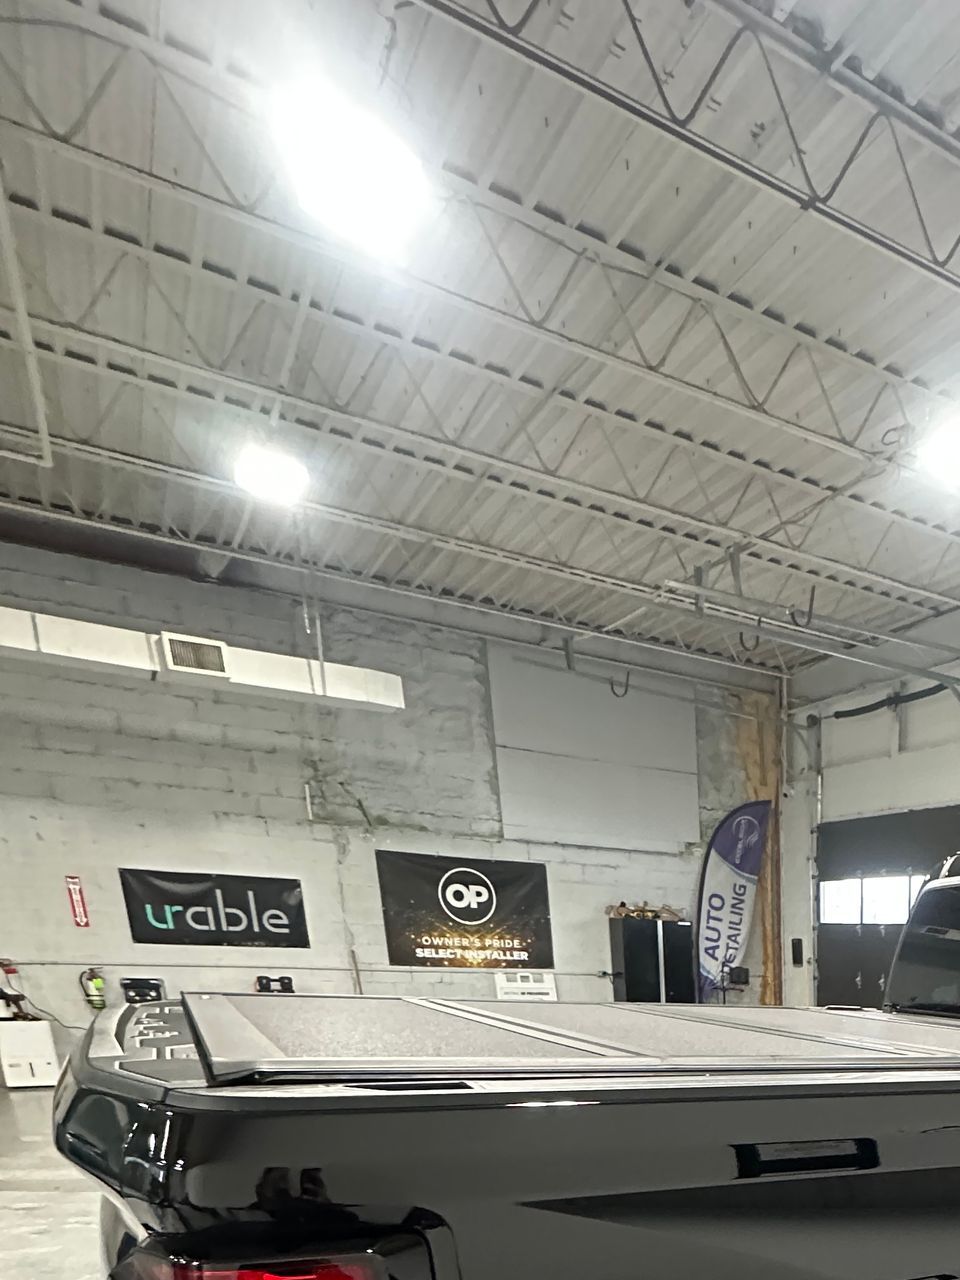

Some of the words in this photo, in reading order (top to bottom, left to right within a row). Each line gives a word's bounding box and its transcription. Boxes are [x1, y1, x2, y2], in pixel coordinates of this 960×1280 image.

[445, 883, 489, 909] OP
[144, 888, 291, 934] urable
[704, 893, 725, 962] AUTO
[415, 948, 462, 959] SELECT
[463, 949, 529, 961] INSTALLER
[421, 936, 481, 948] OWNER'S
[485, 938, 522, 949] PRIDE
